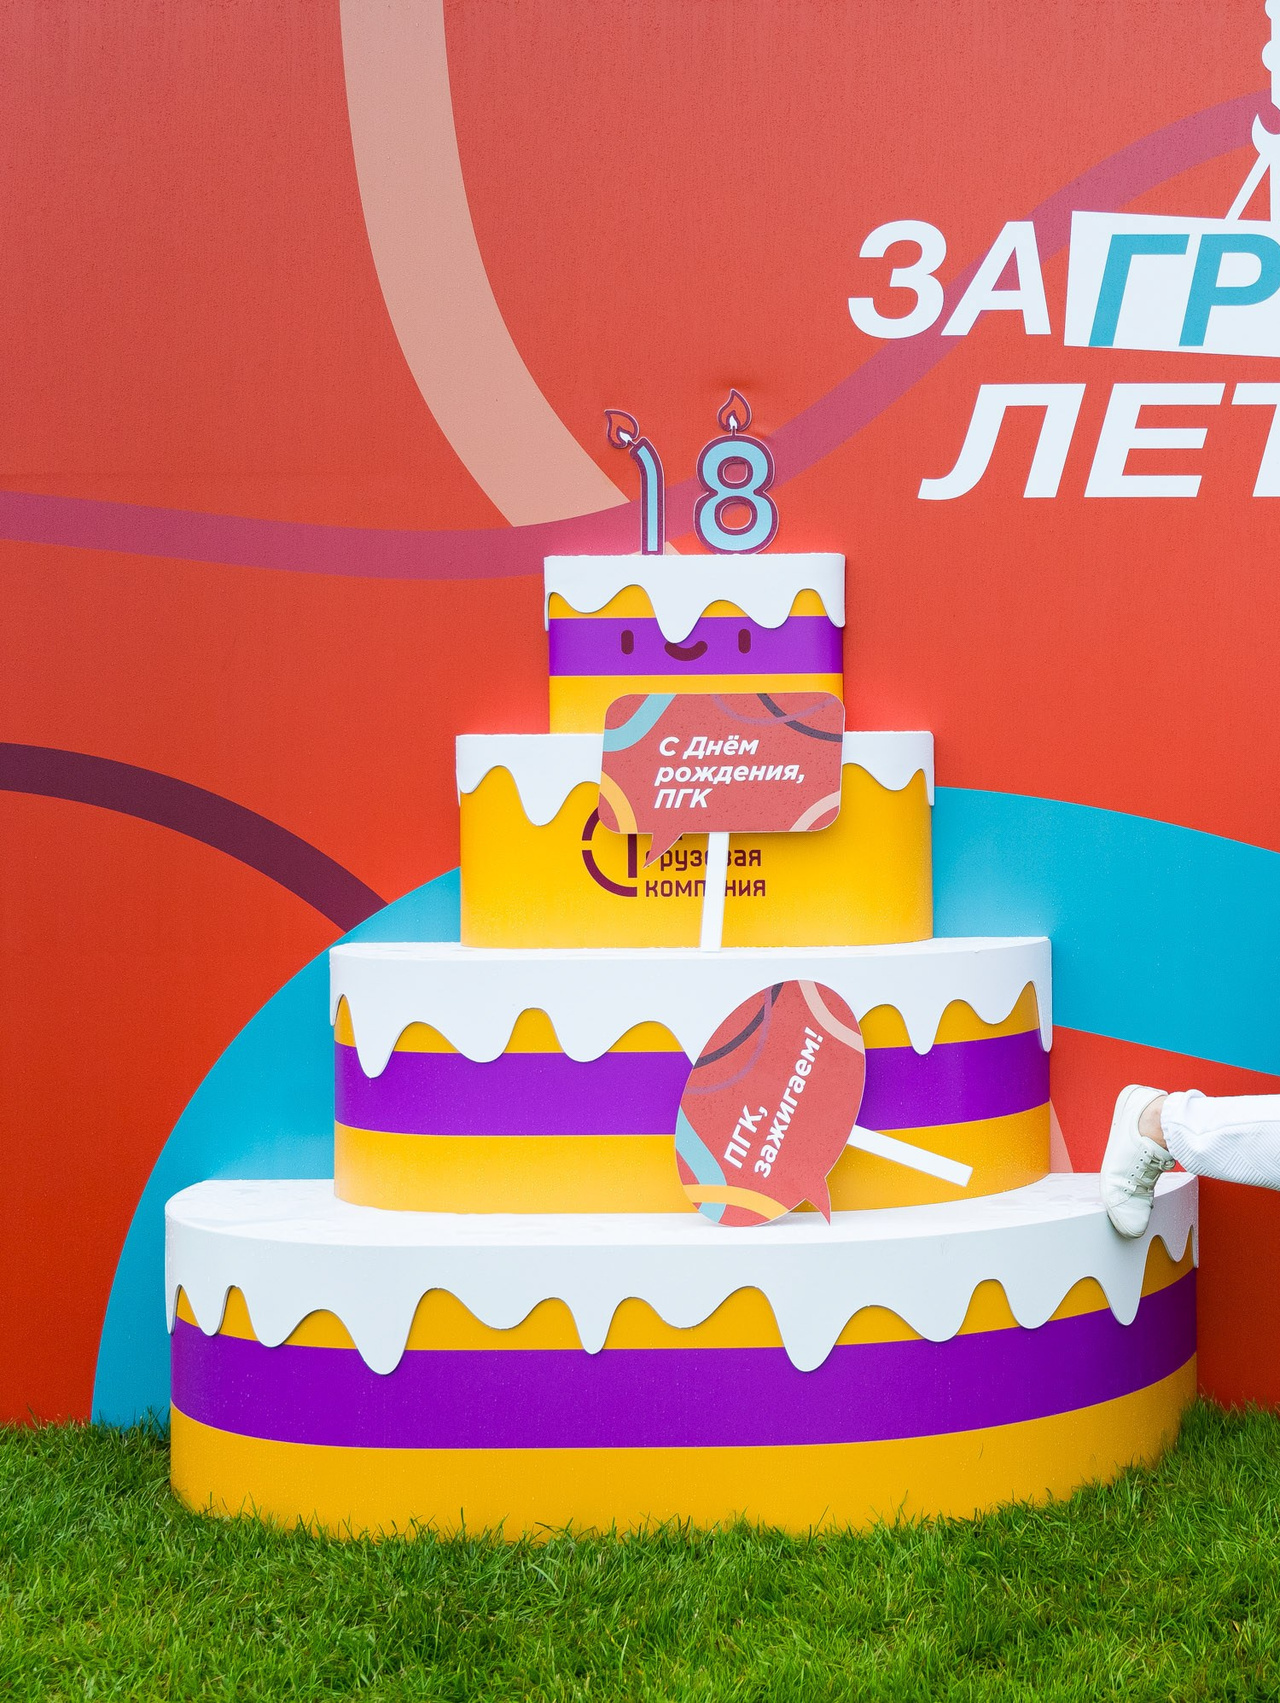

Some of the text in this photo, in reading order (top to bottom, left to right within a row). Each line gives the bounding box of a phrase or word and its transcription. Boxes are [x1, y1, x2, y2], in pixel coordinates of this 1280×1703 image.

[629, 435, 780, 556] 18
[659, 735, 759, 760] С Днём
[654, 764, 805, 786] рождения,
[654, 788, 713, 809] ПГК
[645, 849, 762, 871] рузая
[645, 880, 766, 897] компния
[754, 1026, 824, 1179] зажигаем!
[723, 1105, 768, 1169] ПГК,
